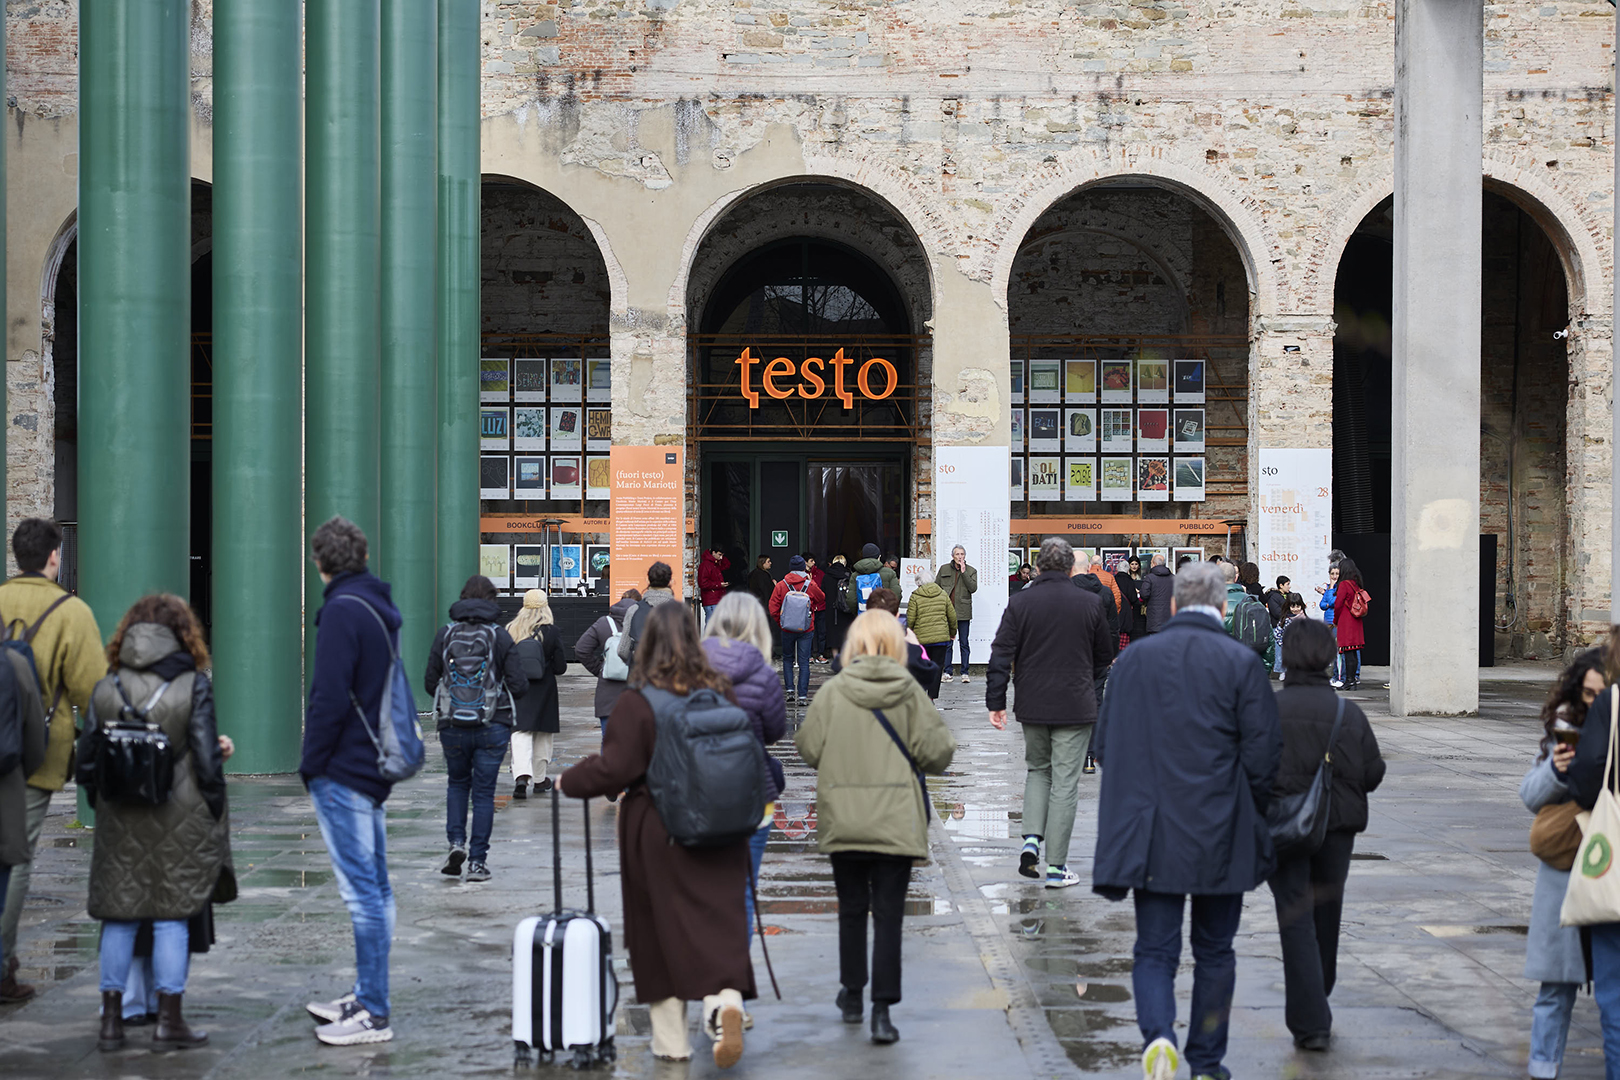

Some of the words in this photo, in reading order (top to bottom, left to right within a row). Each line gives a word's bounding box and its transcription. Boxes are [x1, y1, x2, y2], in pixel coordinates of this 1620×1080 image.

[734, 346, 899, 410] testo
[481, 417, 507, 435] LUZI
[616, 470, 640, 480] (fuori
[641, 470, 664, 480] testo)
[939, 464, 956, 474] sto
[1261, 466, 1279, 476] sto
[1032, 473, 1058, 485] DATI
[616, 481, 641, 489] Mario
[643, 481, 677, 490] Mariotti
[1317, 486, 1329, 498] 28
[1261, 550, 1299, 563] sabato
